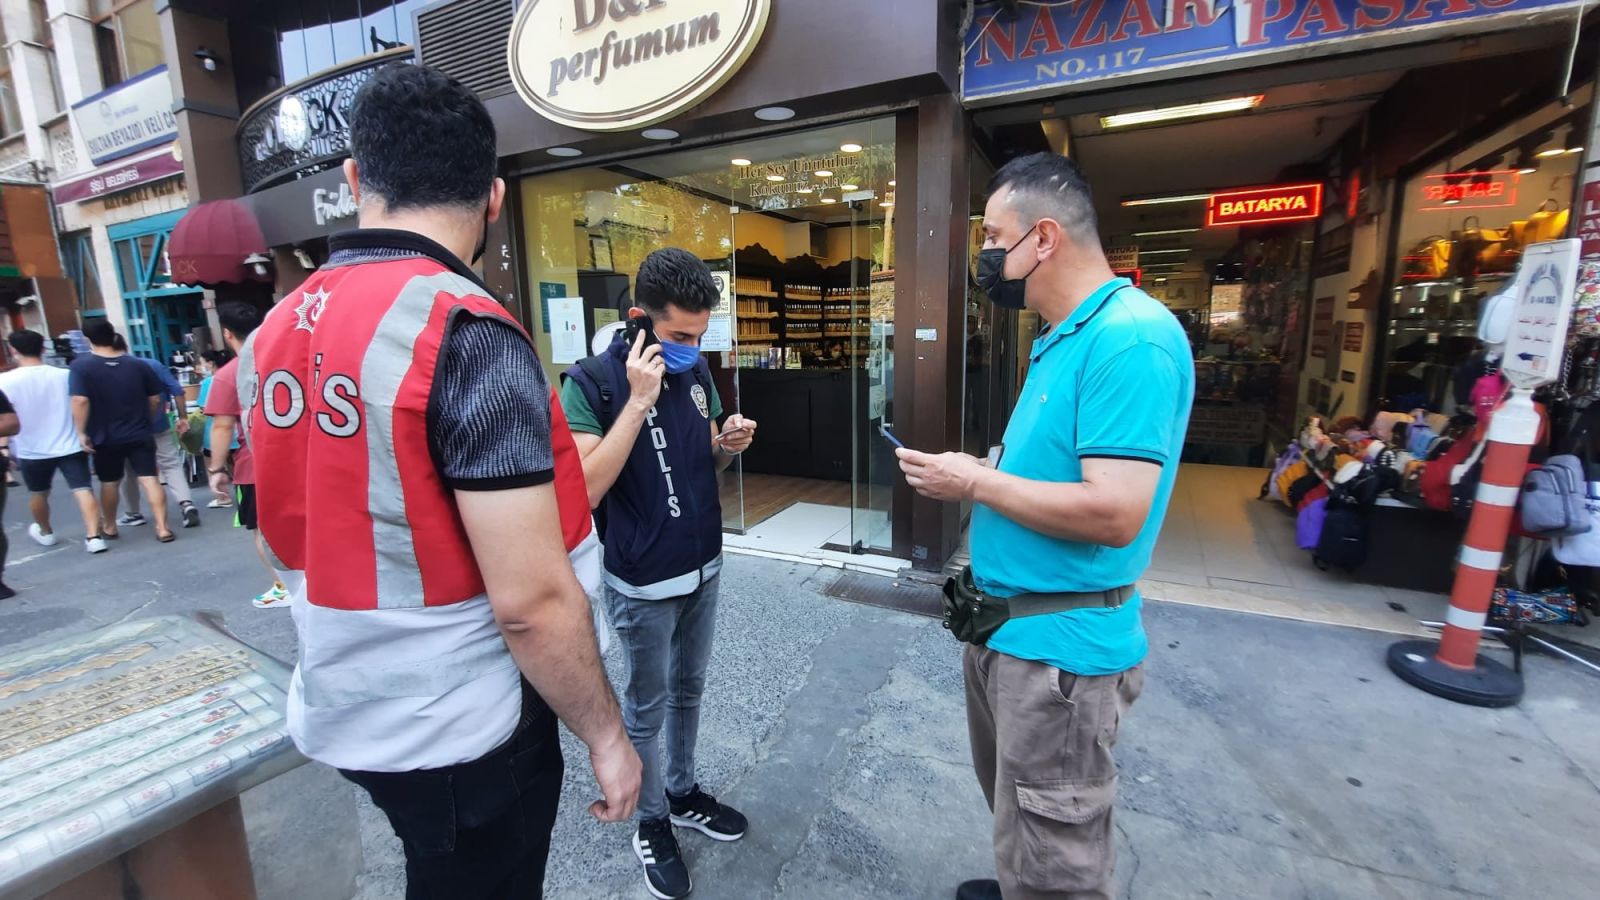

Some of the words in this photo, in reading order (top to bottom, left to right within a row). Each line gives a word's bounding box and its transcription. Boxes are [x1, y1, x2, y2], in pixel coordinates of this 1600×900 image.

[547, 12, 720, 97] perfumum
[1036, 48, 1145, 81] NO.117
[1219, 195, 1308, 216] BATARYA
